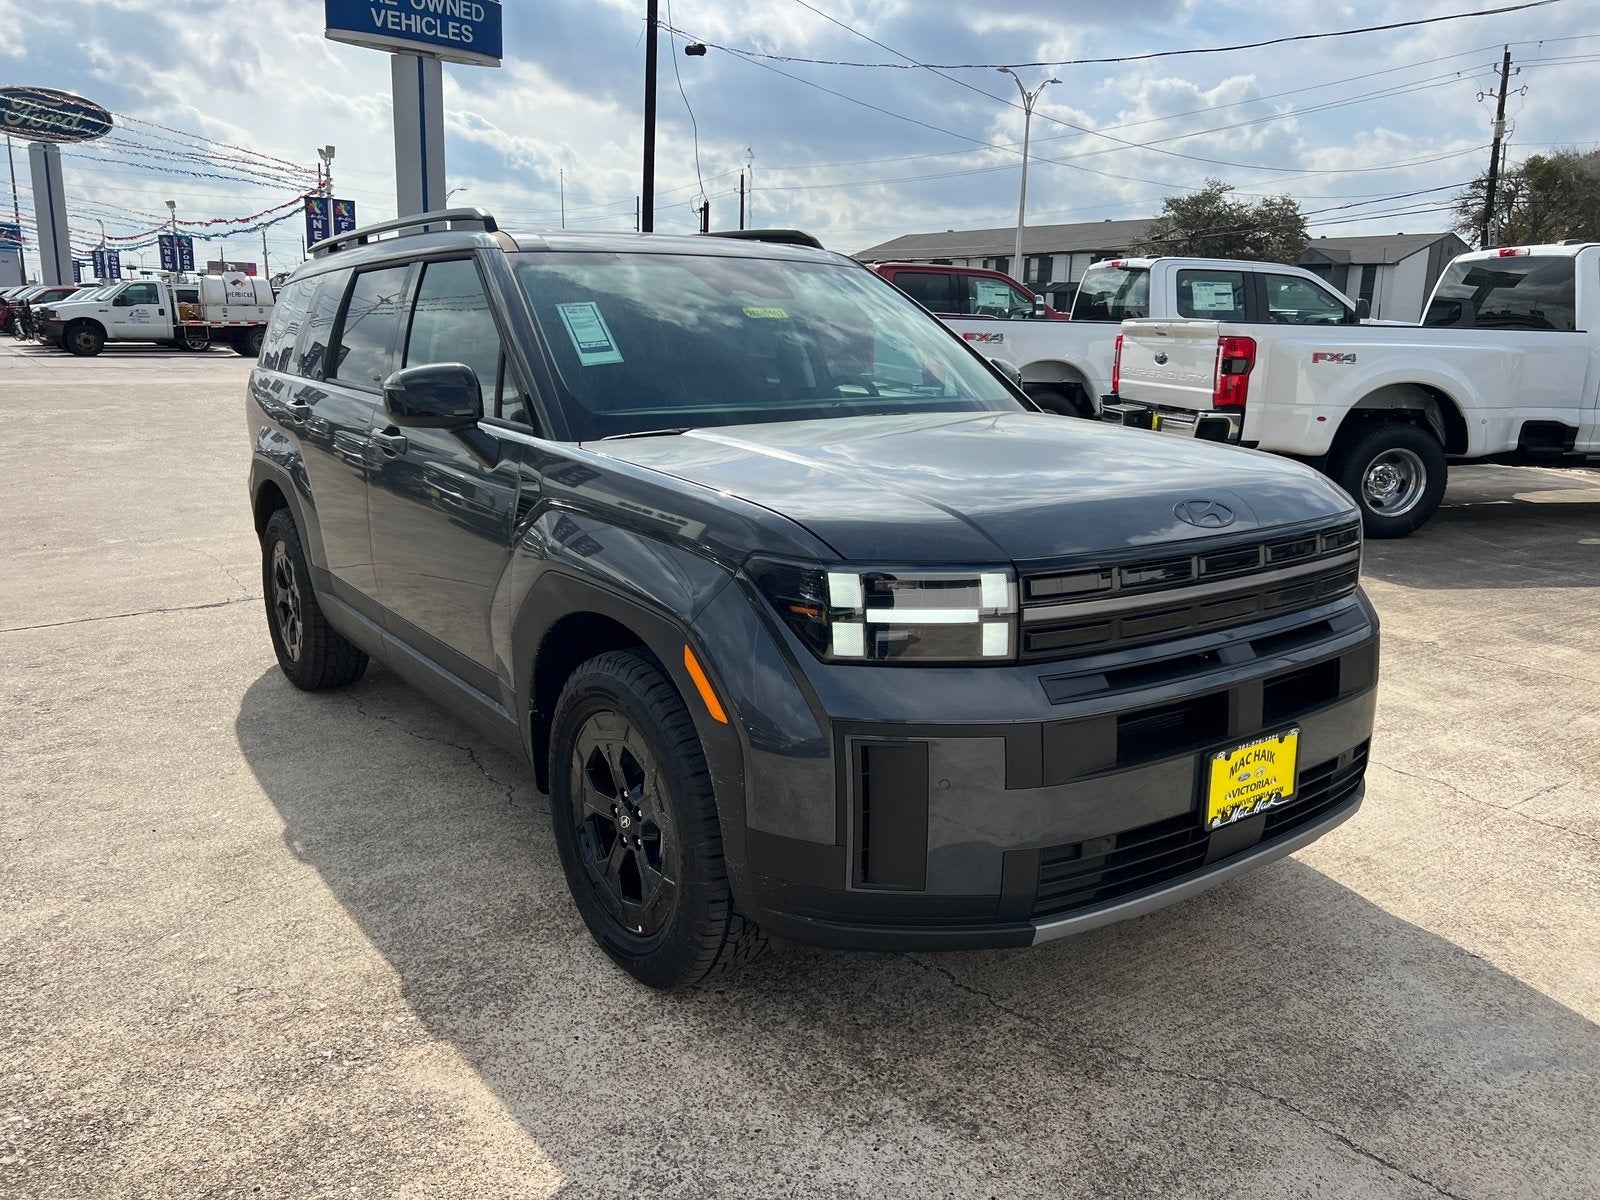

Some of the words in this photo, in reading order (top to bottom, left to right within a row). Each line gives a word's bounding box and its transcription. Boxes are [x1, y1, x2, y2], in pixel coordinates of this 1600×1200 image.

[370, 7, 474, 43] VEHICLES
[4, 97, 84, 132] Ford
[163, 248, 173, 270] NEW
[182, 249, 191, 270] FORD
[962, 332, 1004, 342] FX4
[1311, 352, 1357, 363] FX4
[1122, 366, 1165, 380] SUPER
[1167, 370, 1209, 383] DUTY
[1229, 752, 1252, 779] MAC
[1253, 749, 1276, 764] HAIK
[1231, 777, 1270, 799] VICTORIA
[1229, 806, 1253, 823] Mac
